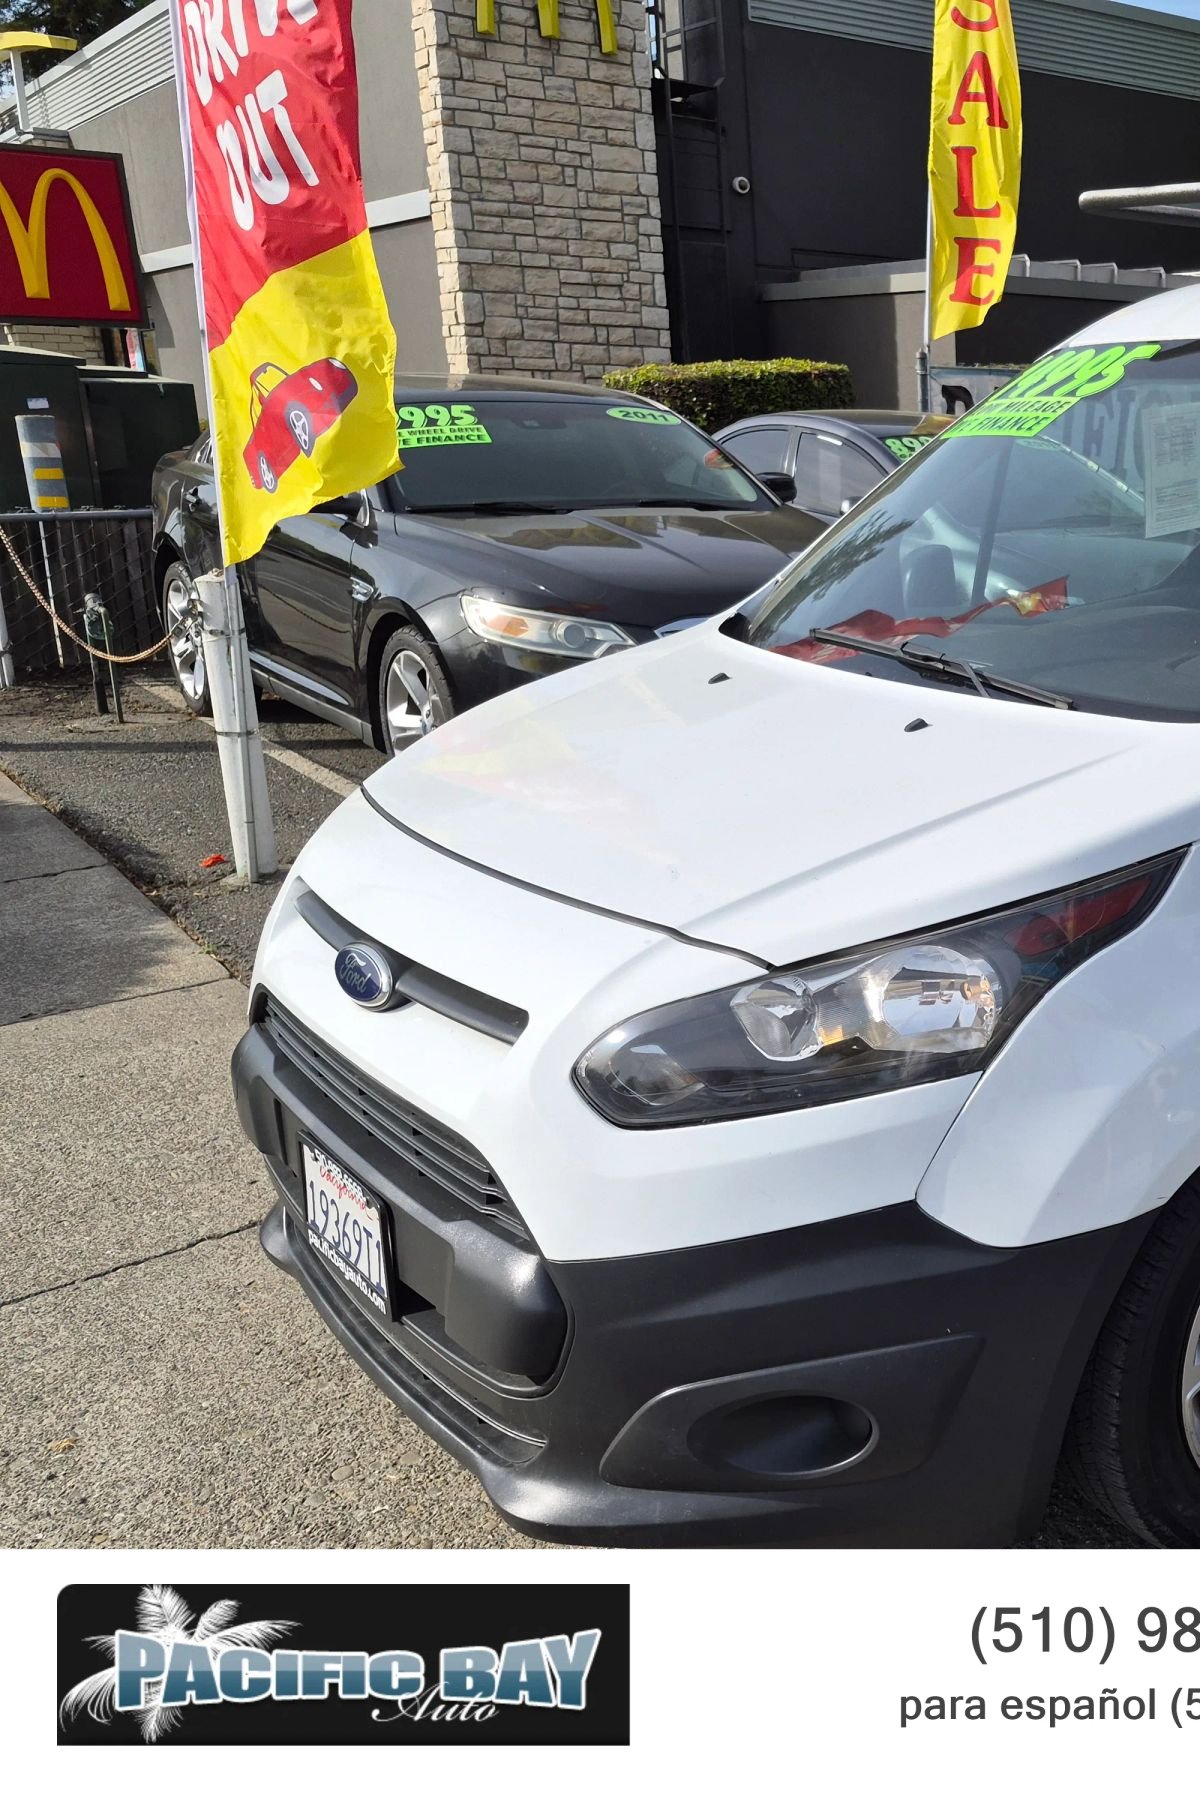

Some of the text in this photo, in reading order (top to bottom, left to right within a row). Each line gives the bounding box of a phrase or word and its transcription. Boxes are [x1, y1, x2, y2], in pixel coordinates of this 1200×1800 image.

[185, 0, 318, 106] DRI
[216, 69, 320, 231] OUT
[397, 404, 478, 429] 995
[1003, 400, 1072, 413] MILEAGE
[407, 427, 445, 437] WHEEL
[449, 426, 483, 434] DRIVE
[969, 416, 1051, 431] FINANCE
[416, 433, 486, 445] FINANCE
[885, 436, 932, 455] 89
[339, 952, 372, 993] Ford
[308, 1180, 386, 1293] 19369T1
